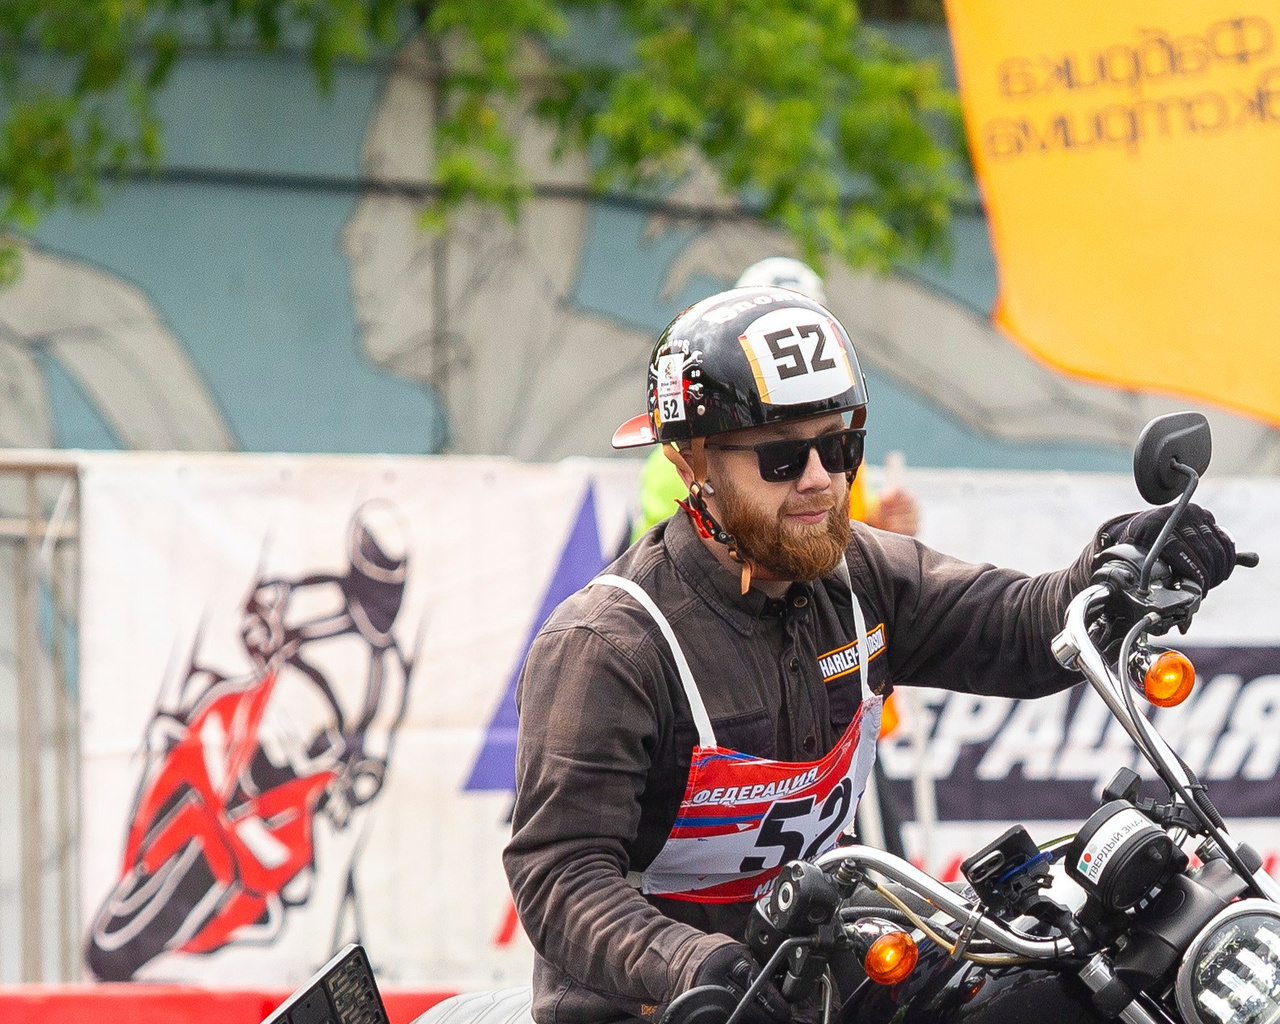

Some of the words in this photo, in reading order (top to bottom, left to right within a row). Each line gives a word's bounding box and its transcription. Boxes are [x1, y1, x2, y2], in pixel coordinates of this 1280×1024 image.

[764, 323, 836, 380] 52
[663, 399, 680, 420] 52
[693, 766, 820, 806] ФЕДЕРАЦИЯ
[739, 777, 854, 873] 52
[1088, 831, 1123, 879] ТВЕРДЫЙ
[1121, 819, 1143, 835] ЗНА
